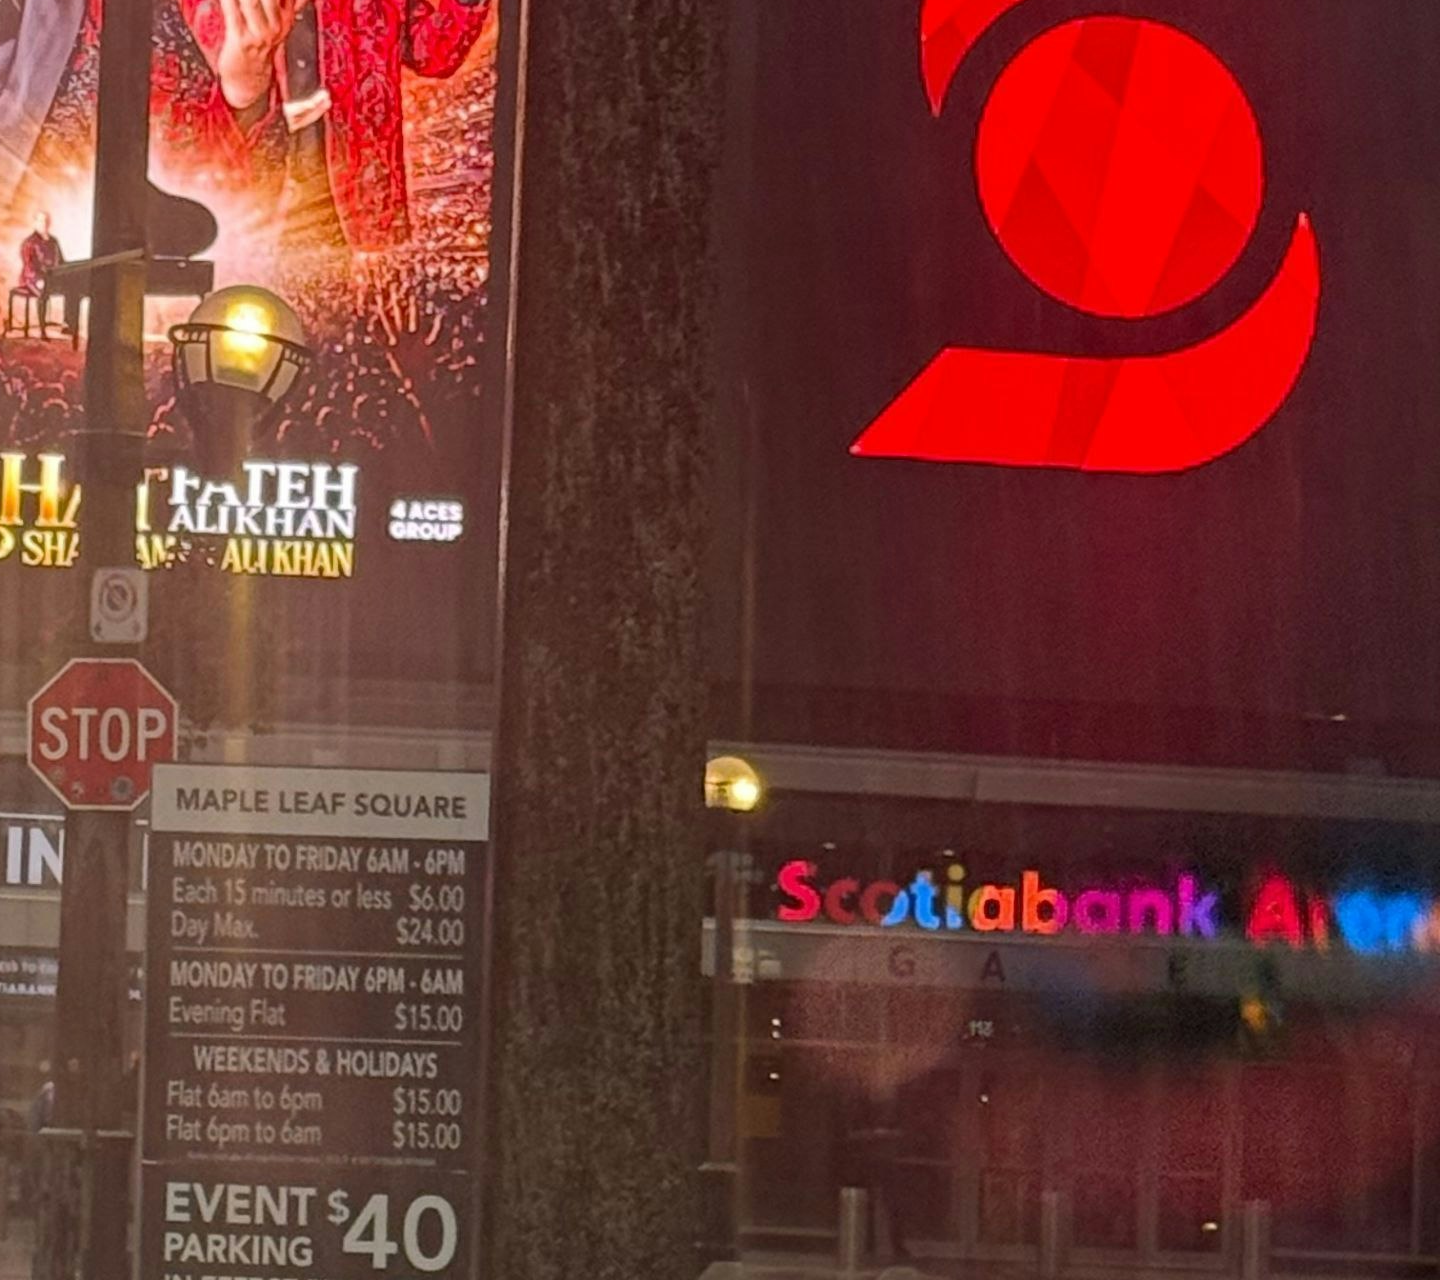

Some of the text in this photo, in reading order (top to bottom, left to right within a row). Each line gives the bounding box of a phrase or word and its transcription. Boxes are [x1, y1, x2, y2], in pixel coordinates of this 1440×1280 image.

[168, 504, 357, 540] ALI KHAN
[408, 500, 463, 522] ACES
[389, 520, 463, 541] GROUP
[221, 537, 267, 575] ALI
[271, 539, 355, 578] KHAN
[38, 705, 168, 763] STOP
[176, 787, 468, 820] MAPLE LEAF SQUARE
[172, 840, 259, 870] MONDAY
[263, 842, 291, 871] TO
[295, 844, 363, 873] FRIDAY
[366, 847, 409, 875] 6AM
[424, 848, 466, 876] 6PM
[172, 877, 465, 914] Each 15 minutes or less $6.00
[776, 859, 1220, 939] Scotiabank
[171, 910, 465, 947] Day Max. $24.00
[170, 960, 257, 990] MONDAY
[261, 962, 290, 991] TO
[293, 964, 361, 993] FRIDAY
[364, 966, 405, 993] 6PM
[421, 968, 464, 996] 6AM
[169, 996, 464, 1033] Evening Flat $15.00
[193, 1044, 439, 1079] WEEKENDS & HOLIDAYS
[166, 1080, 462, 1118] Flat 6am to 6pm $15.00
[166, 1114, 461, 1150] Flat 6pm to 6am $15.00
[164, 1181, 458, 1272] EVENT $40
[163, 1232, 314, 1267] PARKING
